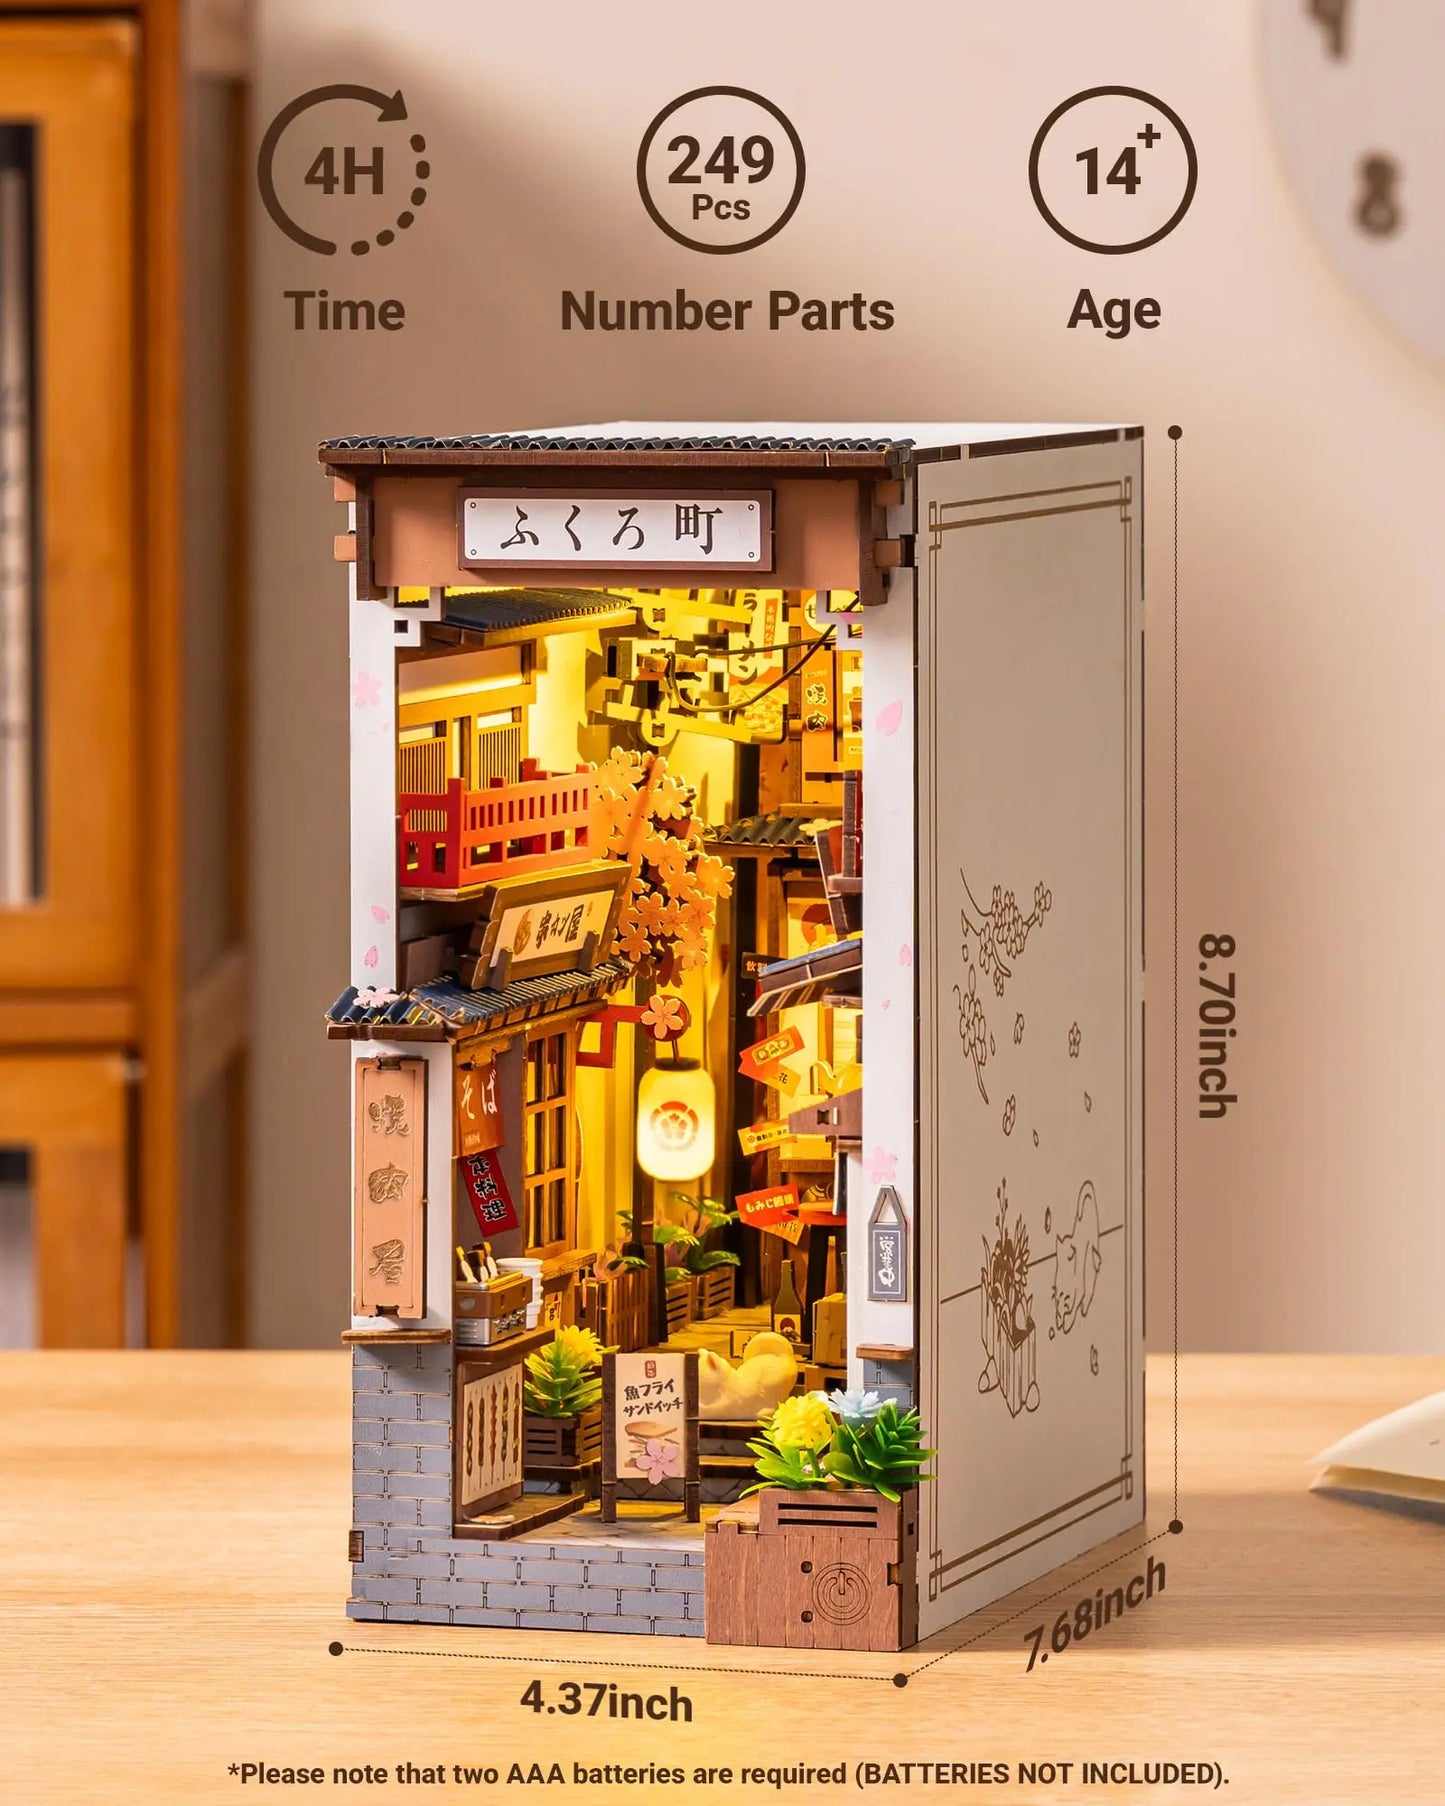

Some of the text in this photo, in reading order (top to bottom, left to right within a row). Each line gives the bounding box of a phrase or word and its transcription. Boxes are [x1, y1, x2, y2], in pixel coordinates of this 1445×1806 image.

[500, 503, 723, 555] ふくろ町
[461, 1069, 498, 1119] そば
[622, 1397, 684, 1417] サンドイッチ
[623, 1378, 675, 1401] 魚フライ
